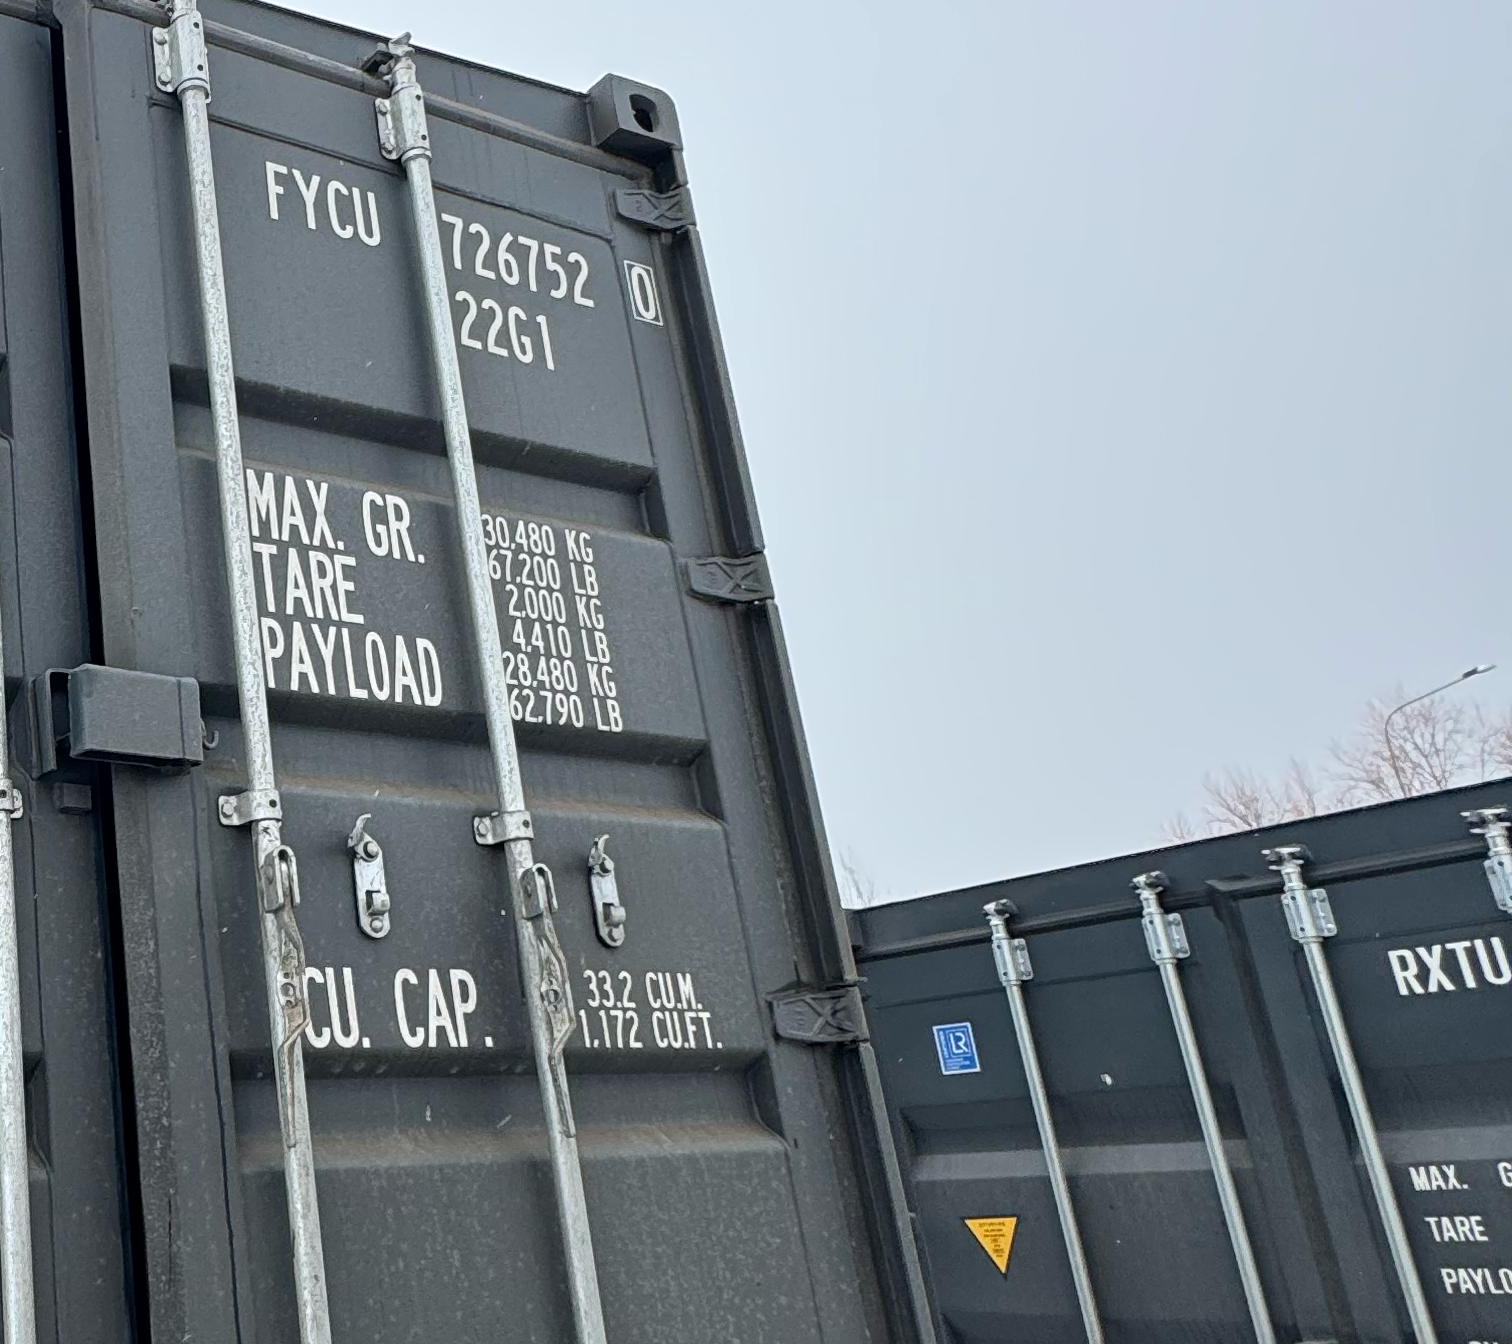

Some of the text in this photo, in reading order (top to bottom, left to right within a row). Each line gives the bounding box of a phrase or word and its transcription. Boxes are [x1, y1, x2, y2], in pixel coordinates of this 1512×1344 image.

[265, 160, 381, 247] FYCU
[440, 212, 657, 321] 726752 0
[454, 290, 555, 371] 22G1
[245, 468, 426, 564] MAX. GR.
[564, 528, 594, 564] KG
[252, 542, 365, 625] TARE
[569, 562, 599, 596] LB
[575, 595, 605, 630] KG
[260, 616, 443, 707] PAYLOAD
[581, 628, 611, 664] LB
[587, 662, 617, 698] KG
[592, 697, 623, 733] LB
[1387, 936, 1512, 996] RXTU
[303, 965, 494, 1049] CU. CAP.
[583, 969, 703, 1009] 33.2 CU.M.
[651, 1010, 723, 1049] CU.FT.
[1408, 1164, 1468, 1191] MAX.
[1424, 1215, 1489, 1242] TARE
